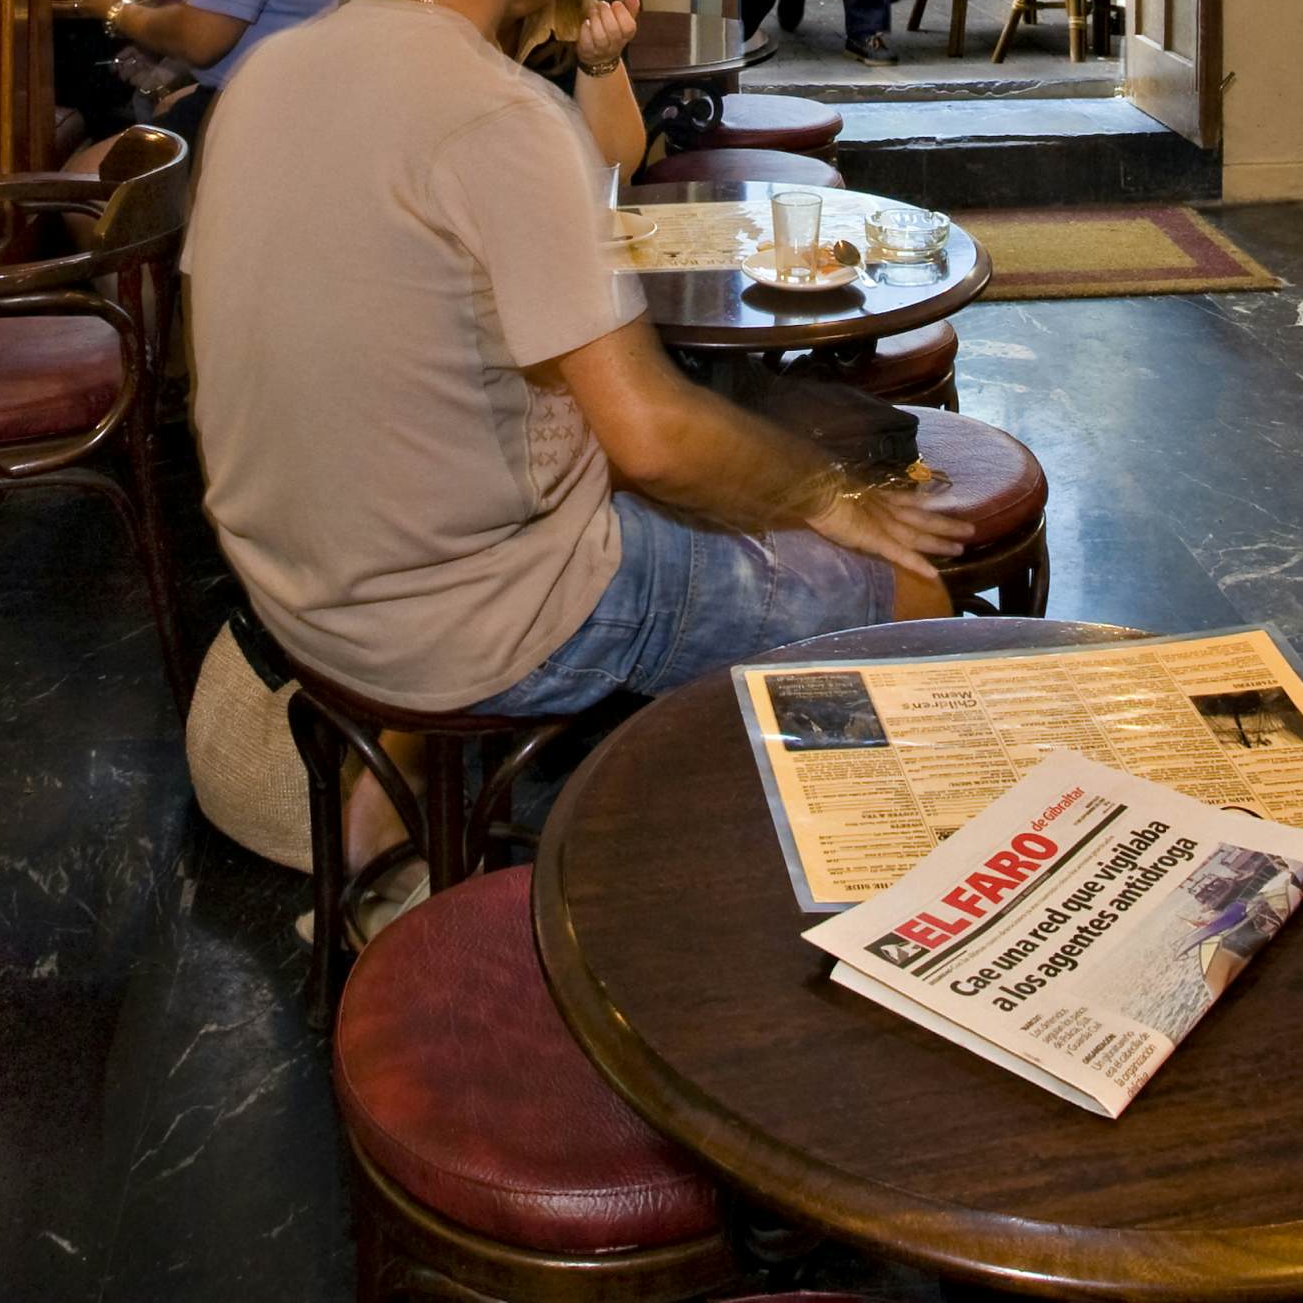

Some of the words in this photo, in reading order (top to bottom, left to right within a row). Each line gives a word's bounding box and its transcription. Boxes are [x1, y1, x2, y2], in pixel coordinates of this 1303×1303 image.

[902, 698, 978, 711] Children's
[931, 690, 973, 700] Menu
[894, 911, 973, 949] EL
[940, 831, 1058, 917] FARO
[1031, 819, 1048, 831] de
[1044, 787, 1084, 819] Gibraltar
[1109, 835, 1197, 912] antidroga
[950, 966, 1000, 997] Cae
[996, 936, 1037, 969] una
[1031, 909, 1071, 941] red
[1066, 877, 1104, 910] que
[1093, 817, 1169, 882] vigilaba
[1040, 908, 1119, 977] agentes
[992, 992, 1017, 1013] a
[999, 972, 1046, 1001] los
